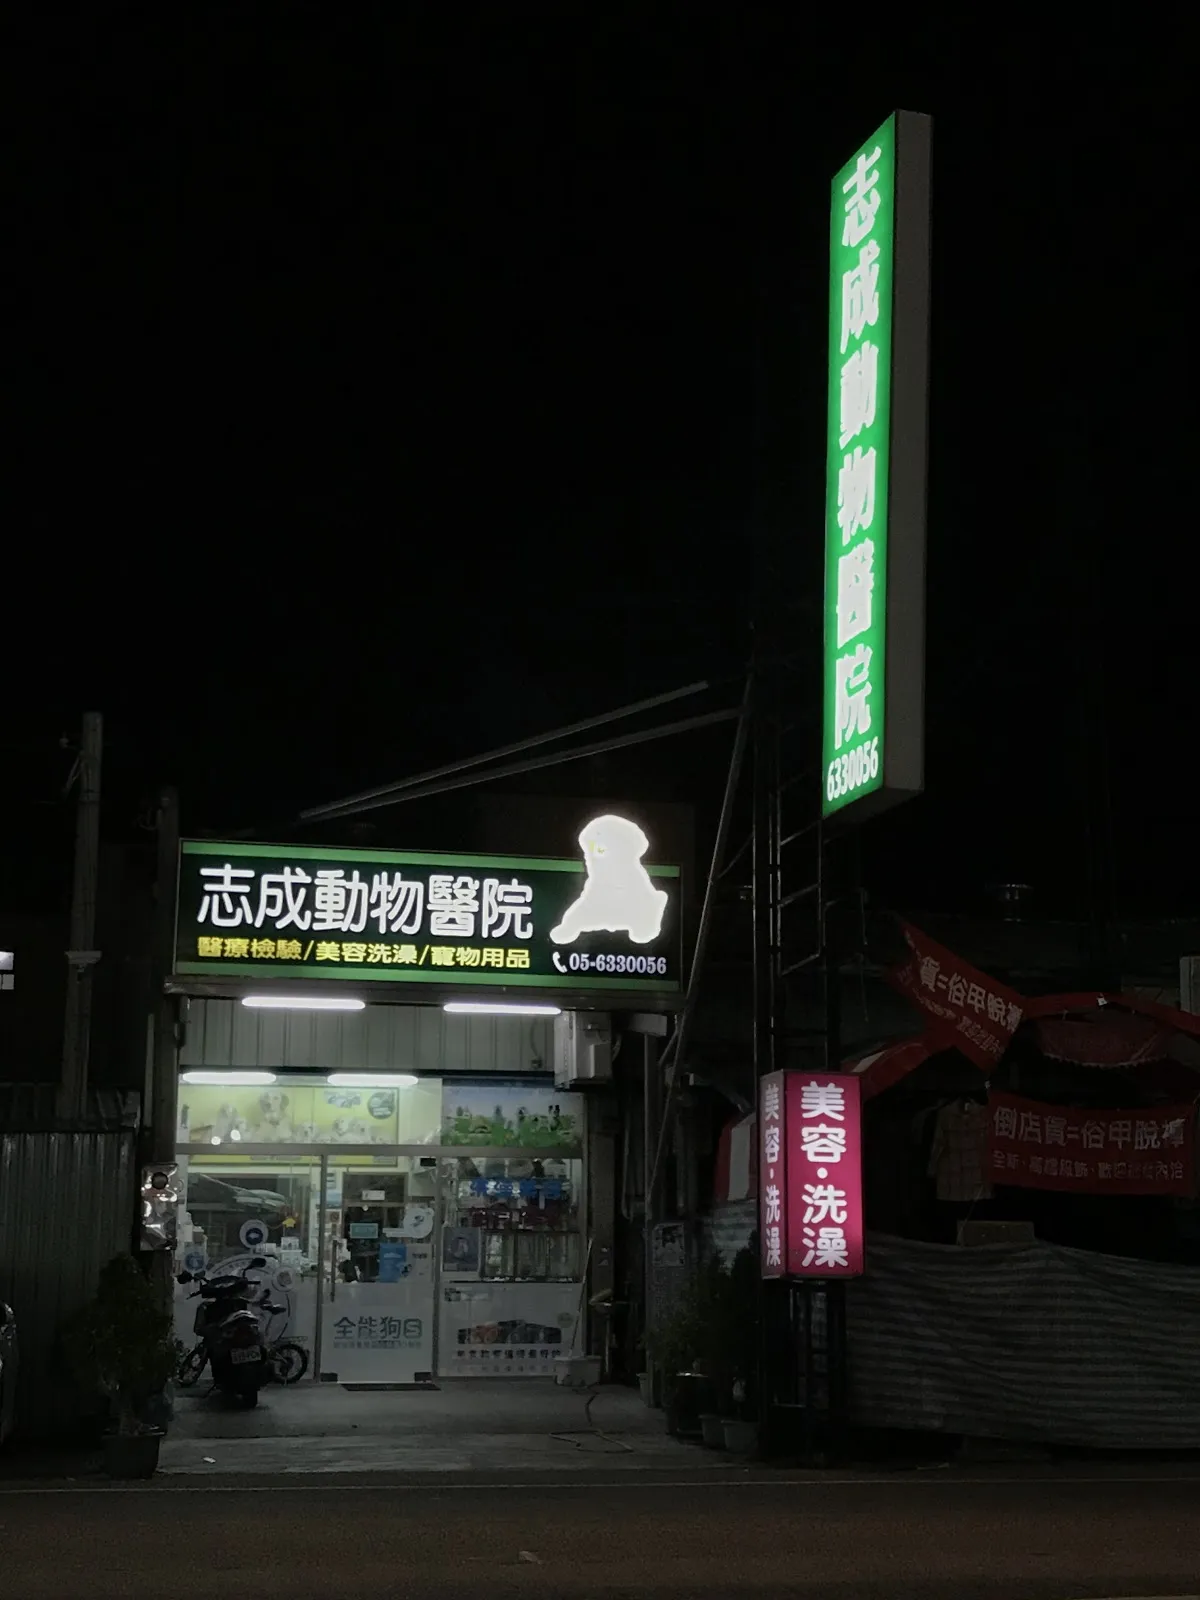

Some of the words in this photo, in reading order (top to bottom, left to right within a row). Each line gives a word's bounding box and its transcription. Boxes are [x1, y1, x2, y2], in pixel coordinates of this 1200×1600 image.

[835, 146, 881, 750] 志成動物醫院
[827, 736, 879, 802] 6330056
[198, 862, 534, 940] 志成動物醫院
[197, 936, 531, 969] 醫療檢驗/美容洗澡/寵物用品
[568, 952, 667, 975] 05-6330056
